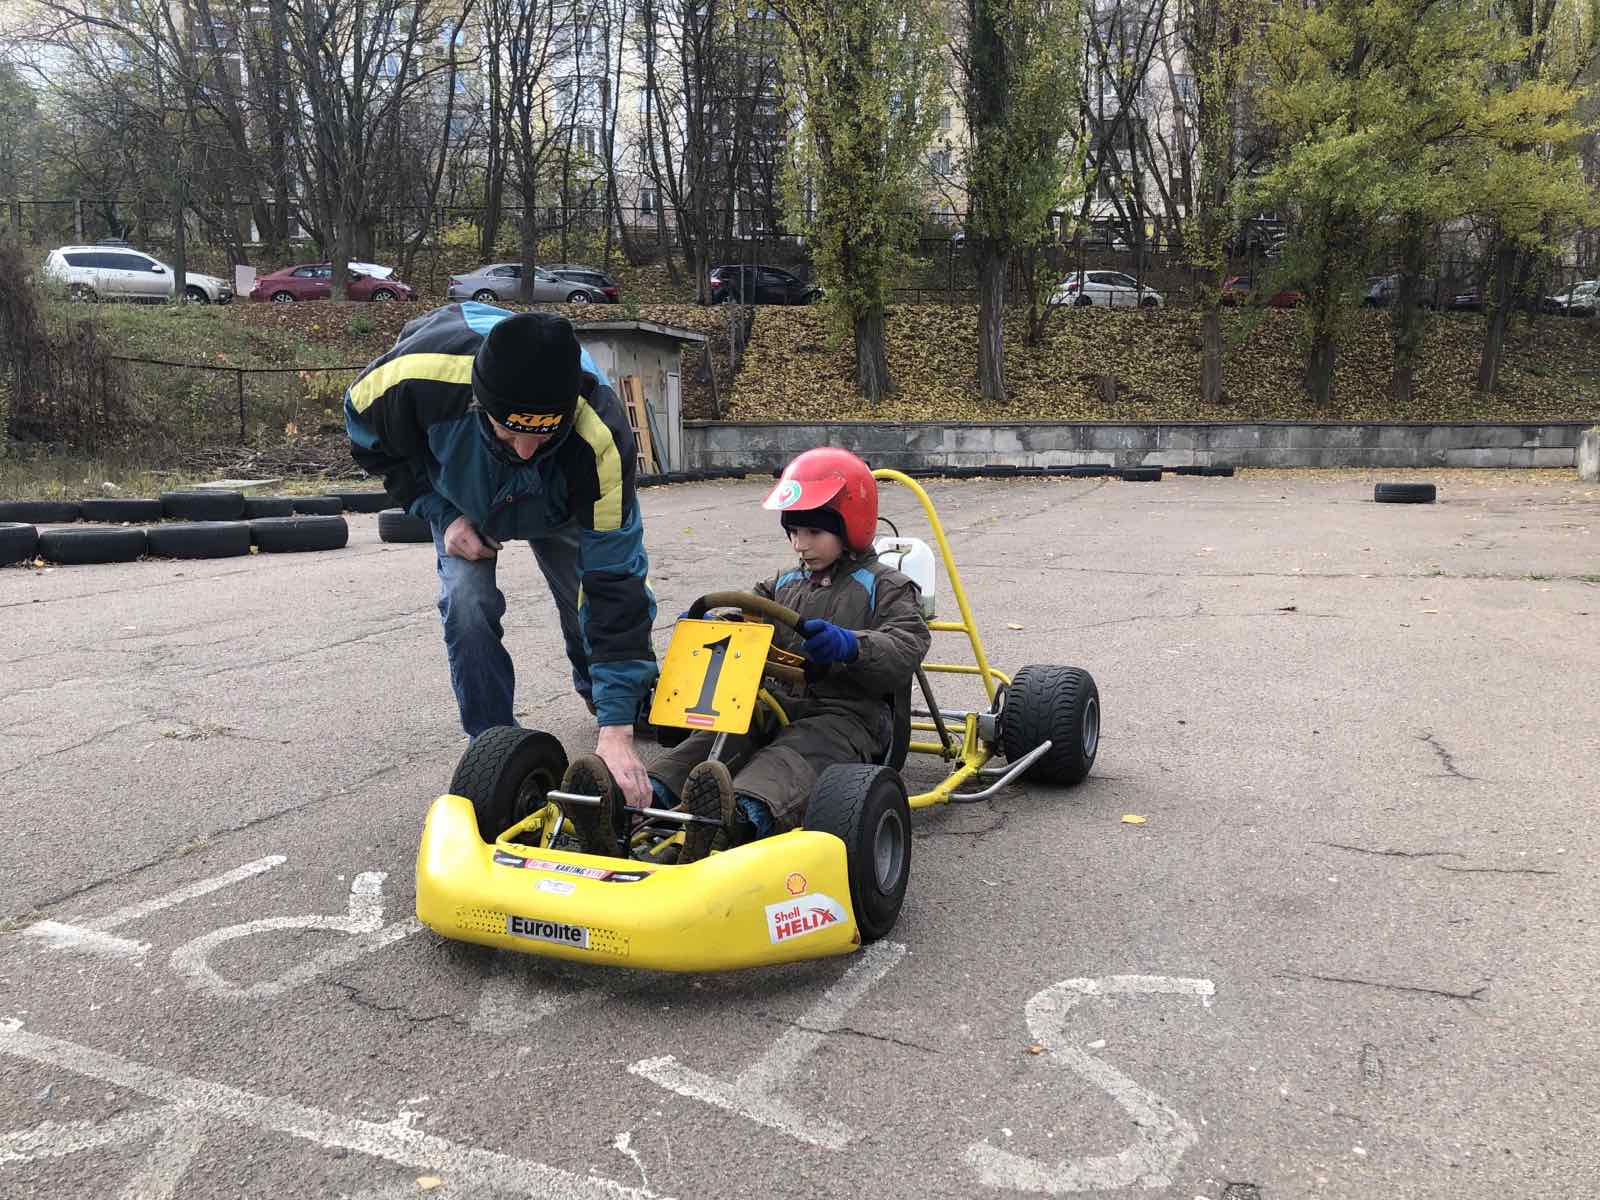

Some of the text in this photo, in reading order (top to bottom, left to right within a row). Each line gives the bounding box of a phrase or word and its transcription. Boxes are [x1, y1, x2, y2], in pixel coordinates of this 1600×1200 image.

[507, 413, 563, 427] KTM
[685, 635, 732, 716] 1
[554, 863, 587, 876] KARTING
[774, 904, 802, 924] Shell
[776, 909, 837, 940] HELIX
[511, 915, 582, 943] Eurolite
